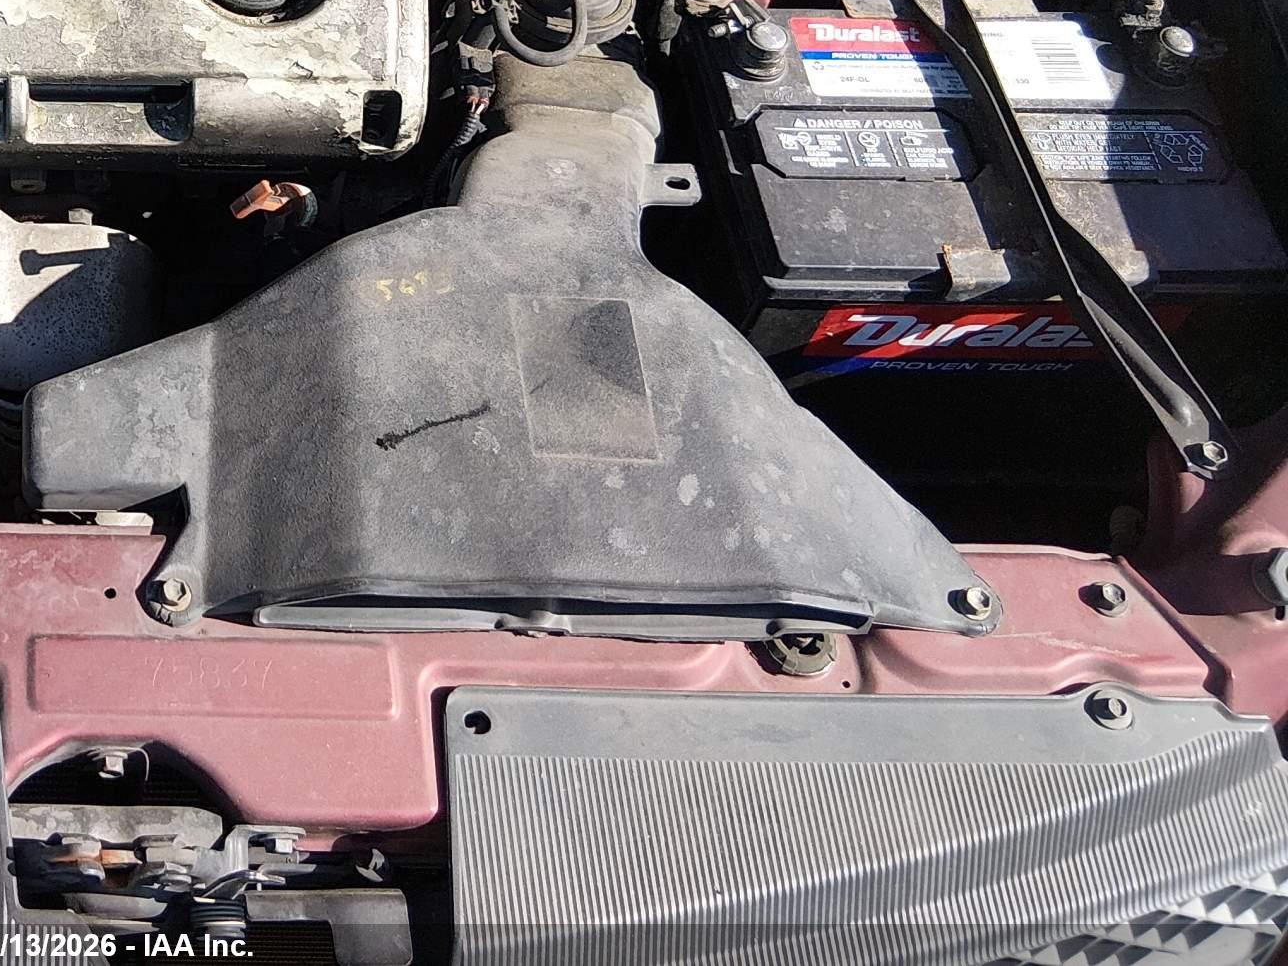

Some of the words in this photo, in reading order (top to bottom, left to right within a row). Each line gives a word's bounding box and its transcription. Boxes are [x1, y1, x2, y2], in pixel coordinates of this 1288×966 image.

[807, 23, 921, 43] Duralast
[831, 52, 877, 60] PROVEN
[806, 119, 861, 129] DANGER
[873, 119, 924, 130] POISON
[842, 313, 1094, 348] Durala
[870, 360, 978, 371] PROVEN
[987, 361, 1075, 372] TOUGH
